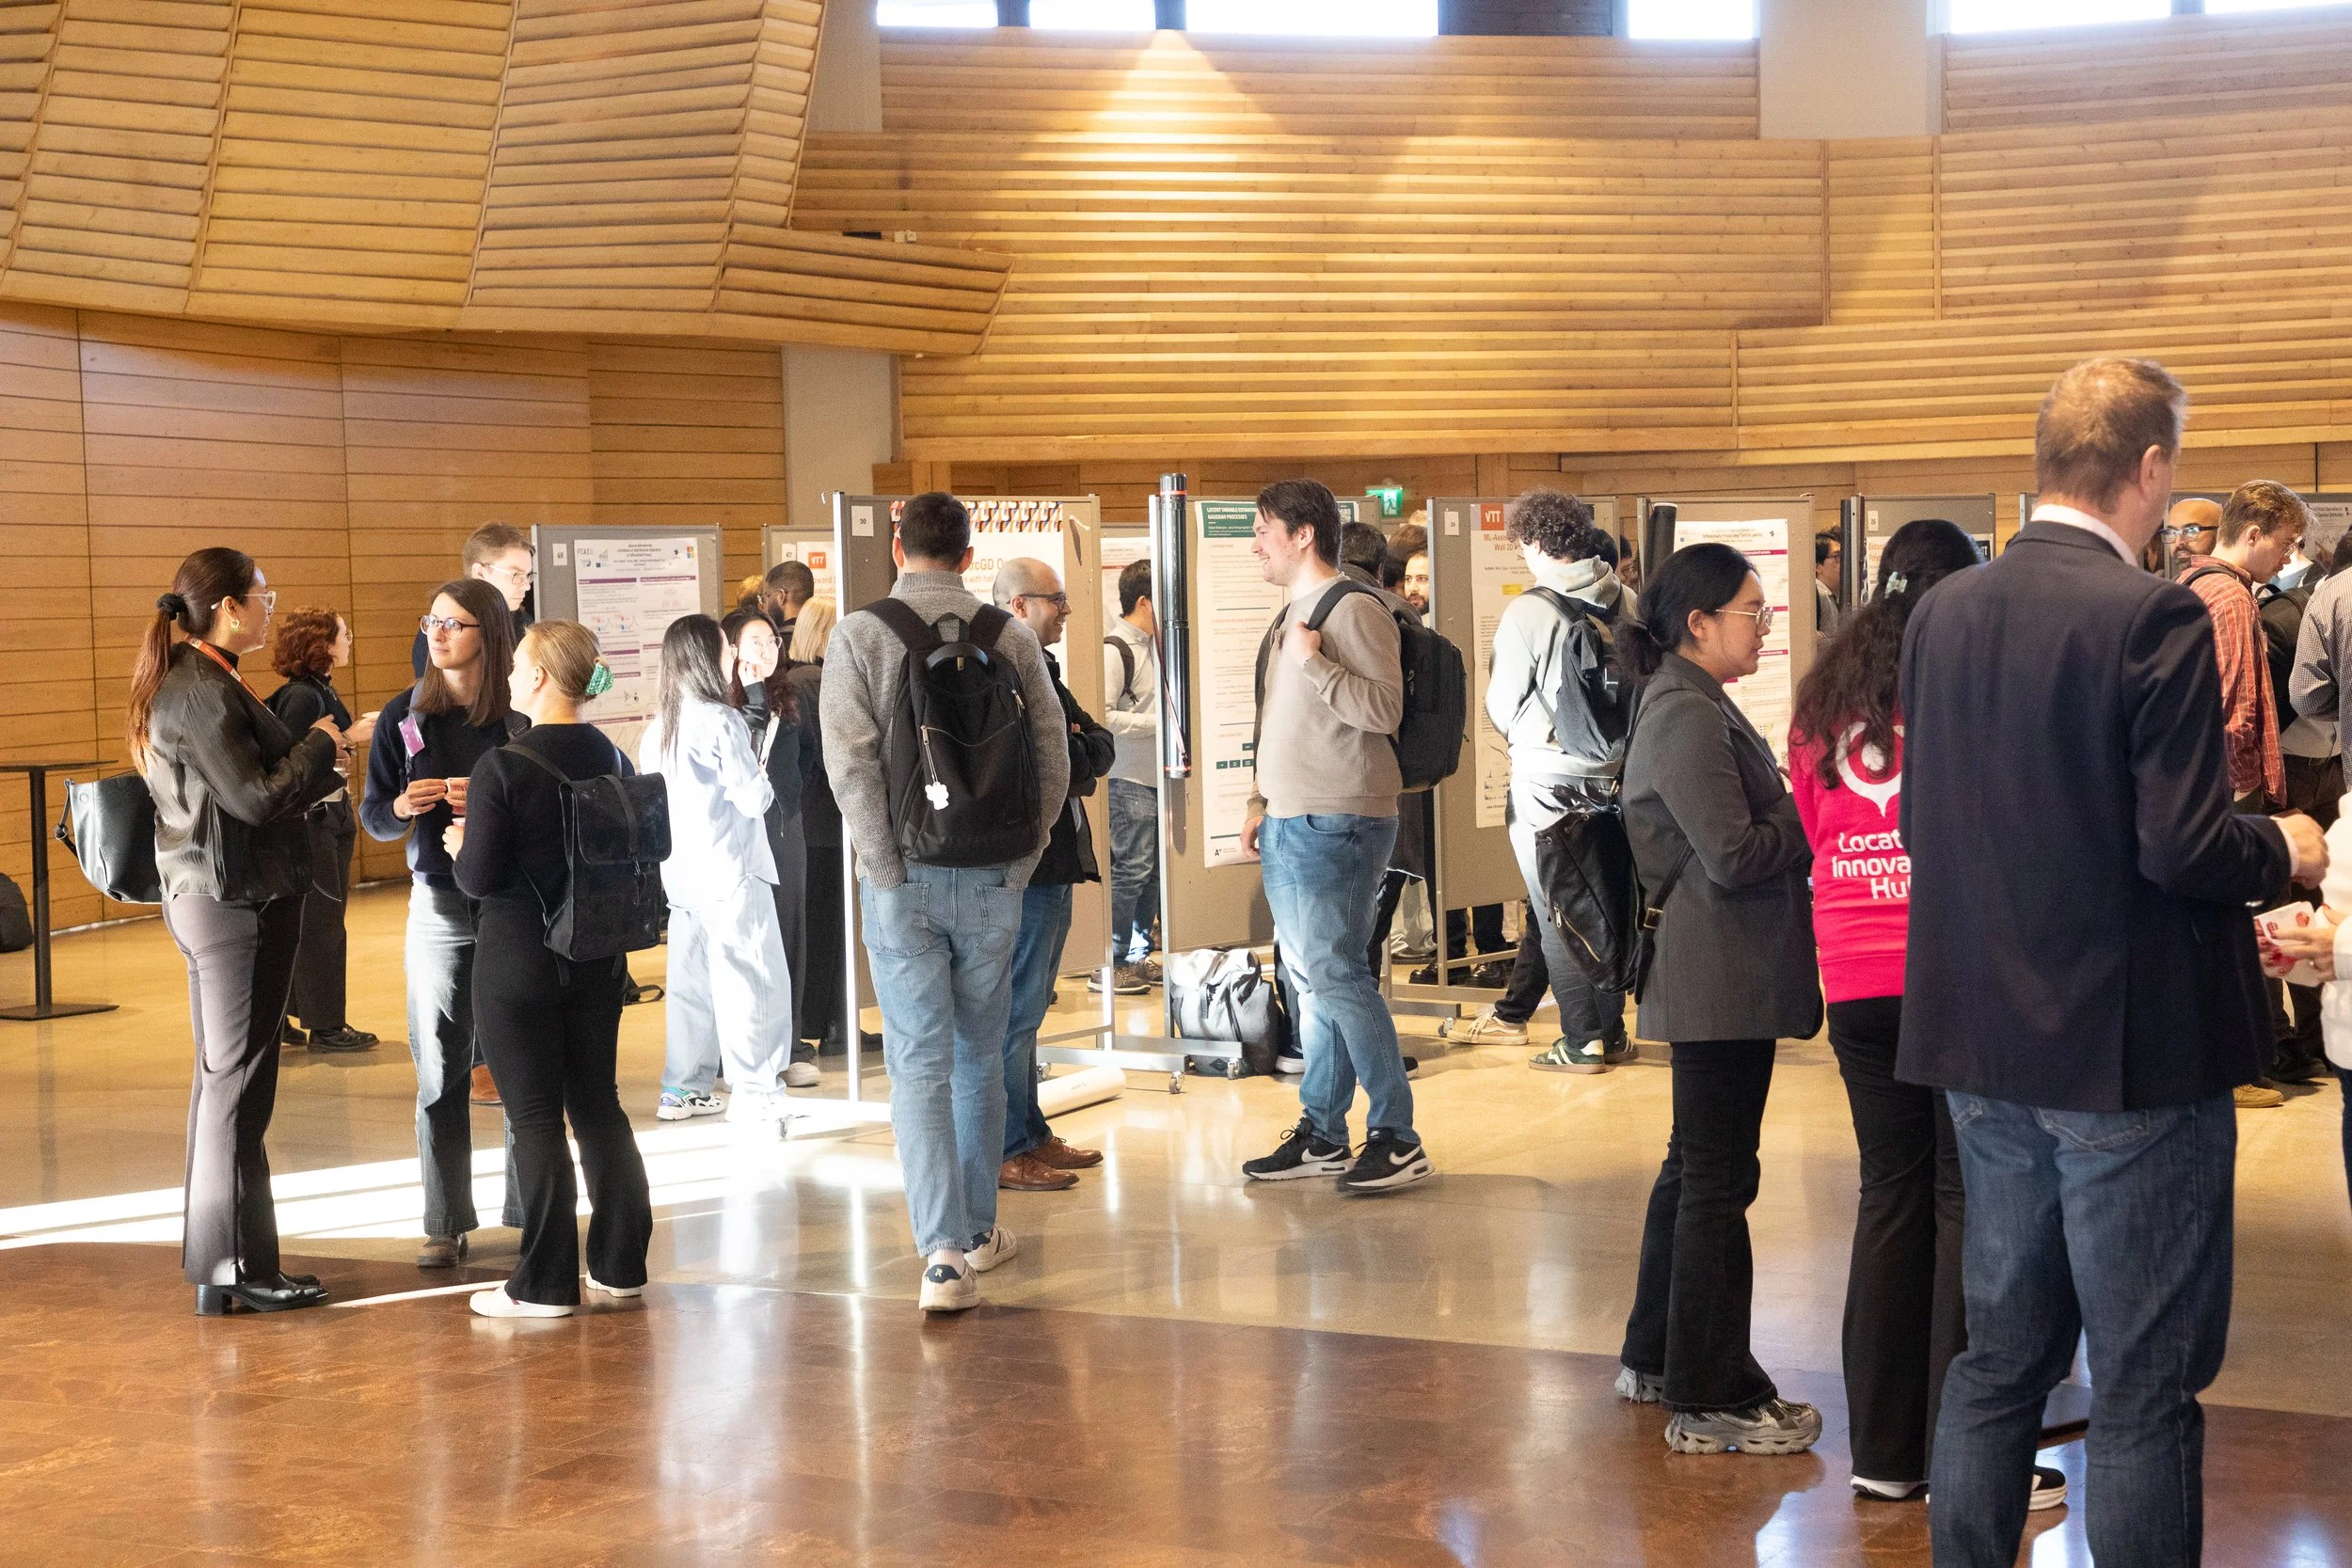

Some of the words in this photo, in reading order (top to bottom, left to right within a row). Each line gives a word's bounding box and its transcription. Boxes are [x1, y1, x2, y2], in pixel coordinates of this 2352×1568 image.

[1486, 510, 1502, 524] VTT
[811, 556, 825, 564] VTT
[1837, 829, 1903, 853] Locat
[1831, 855, 1912, 878] Innova
